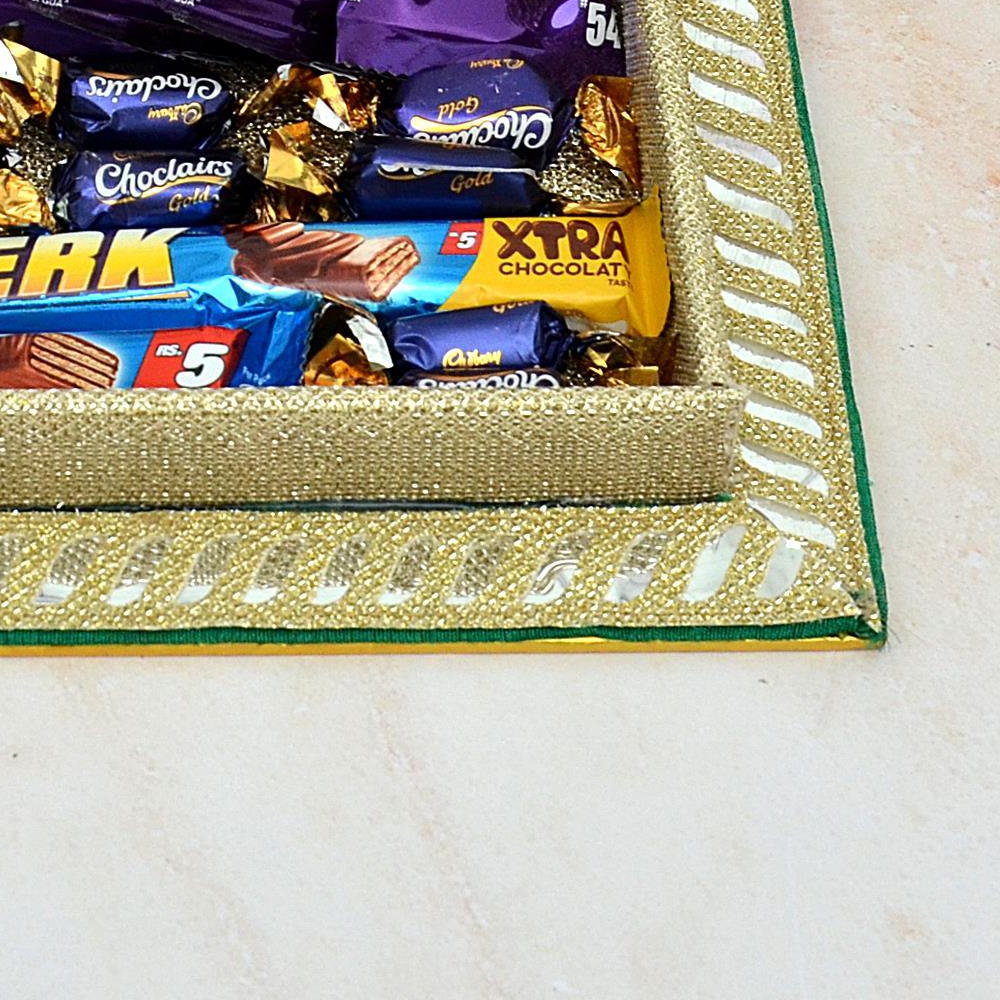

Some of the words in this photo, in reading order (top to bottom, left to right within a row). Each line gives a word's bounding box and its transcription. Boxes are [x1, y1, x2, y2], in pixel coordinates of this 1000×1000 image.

[86, 73, 222, 104] Choclairs
[438, 95, 481, 121] Gold
[95, 156, 233, 198] Choclairs
[450, 171, 495, 194] Gold
[168, 185, 211, 213] Gold
[492, 220, 630, 264] XTRA
[175, 342, 230, 389] 5
